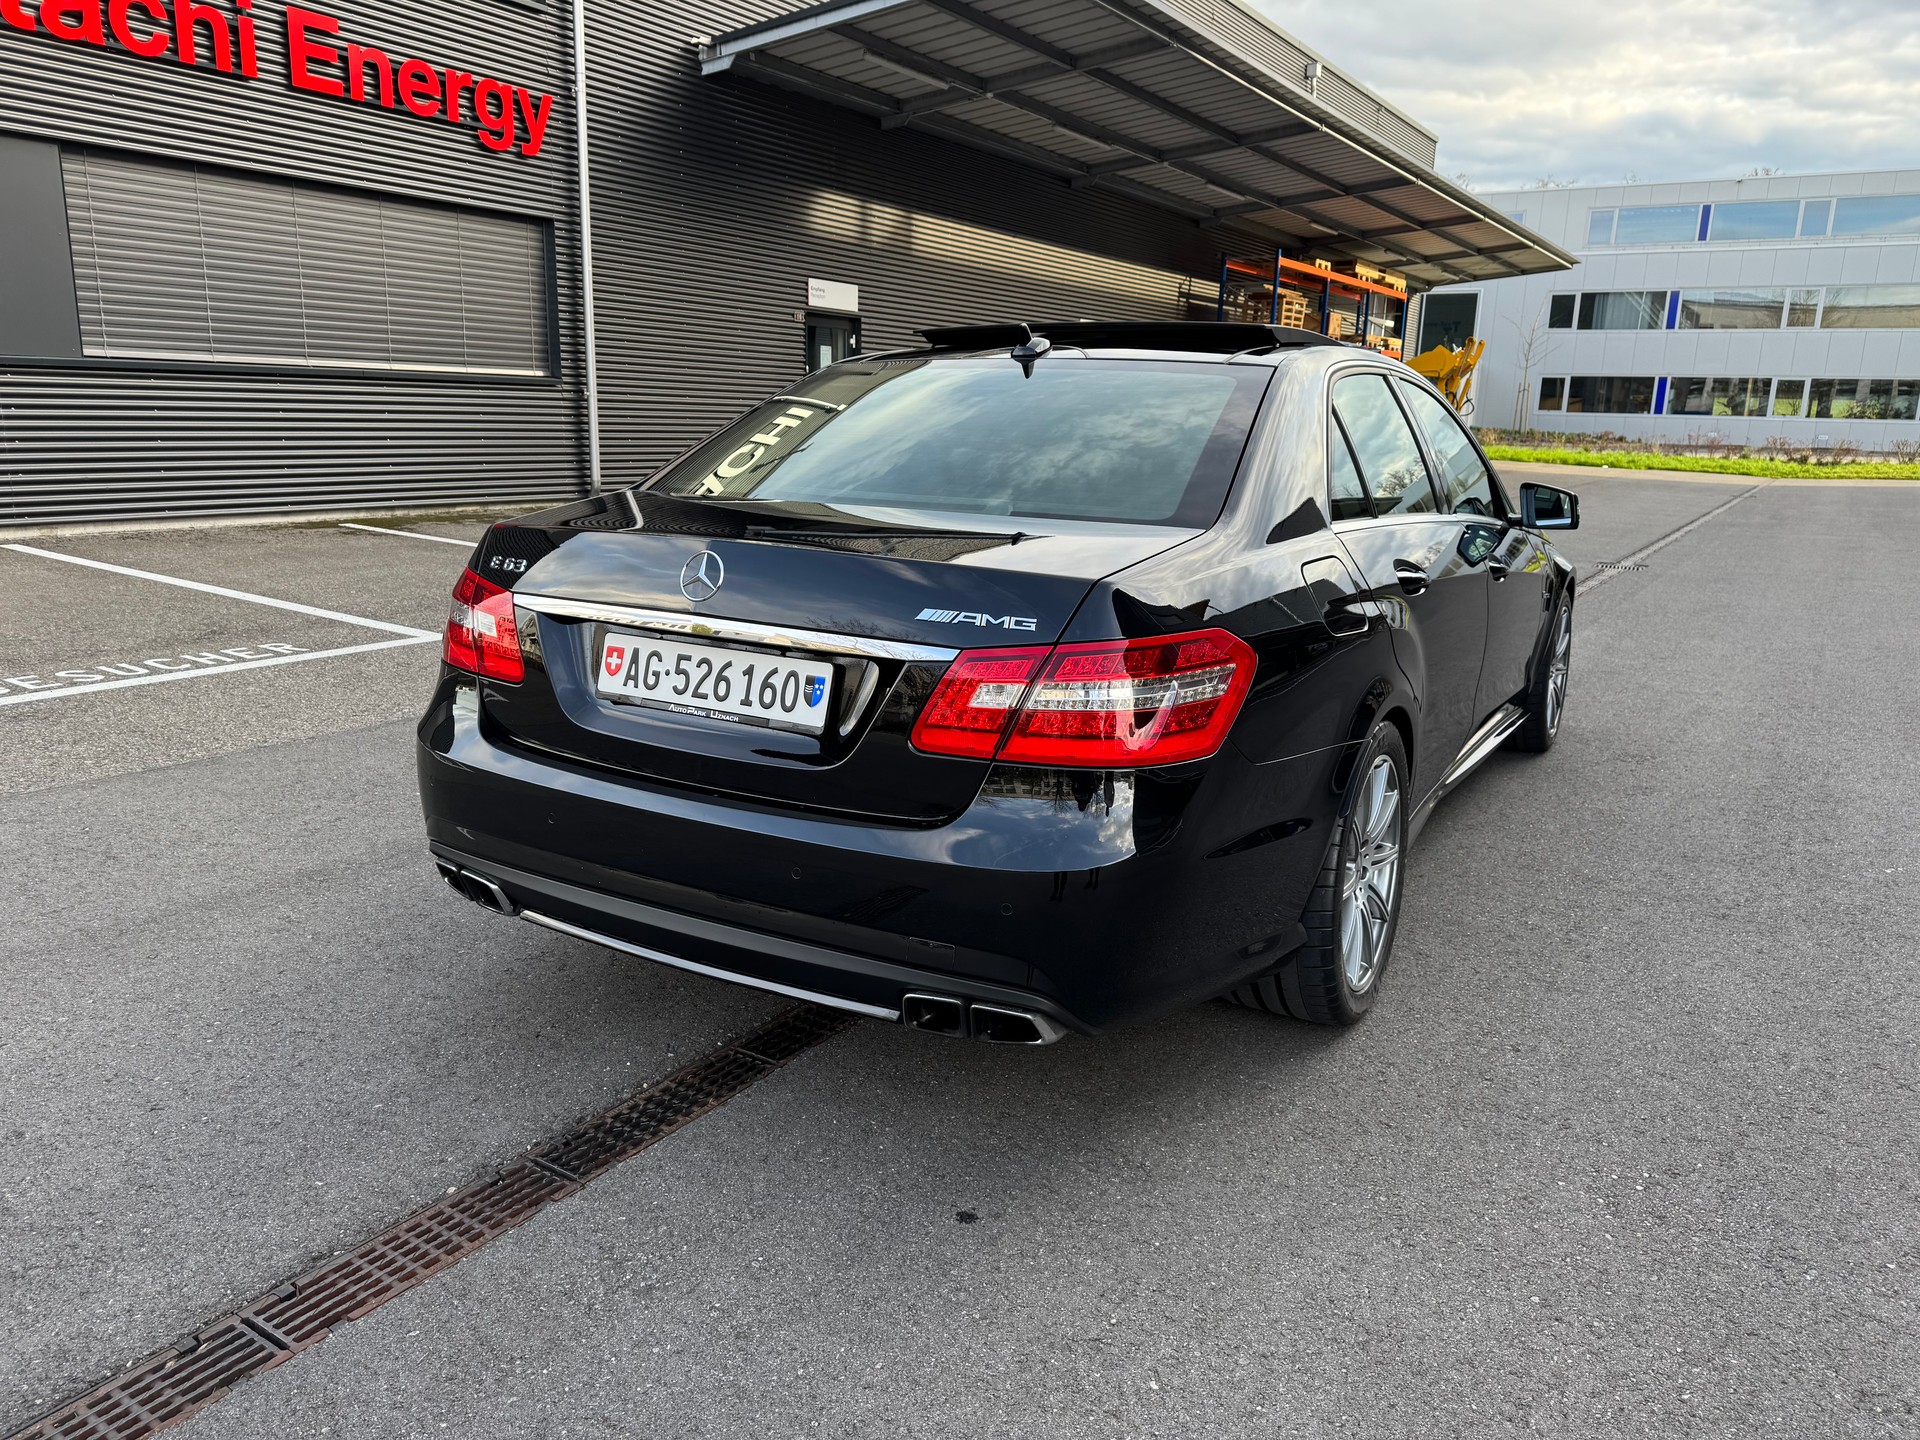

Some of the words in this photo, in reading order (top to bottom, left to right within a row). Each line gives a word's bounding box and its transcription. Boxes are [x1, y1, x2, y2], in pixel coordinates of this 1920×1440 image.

[286, 5, 553, 156] Energy
[951, 611, 1037, 631] AMG
[0, 642, 310, 695] ESUCHER
